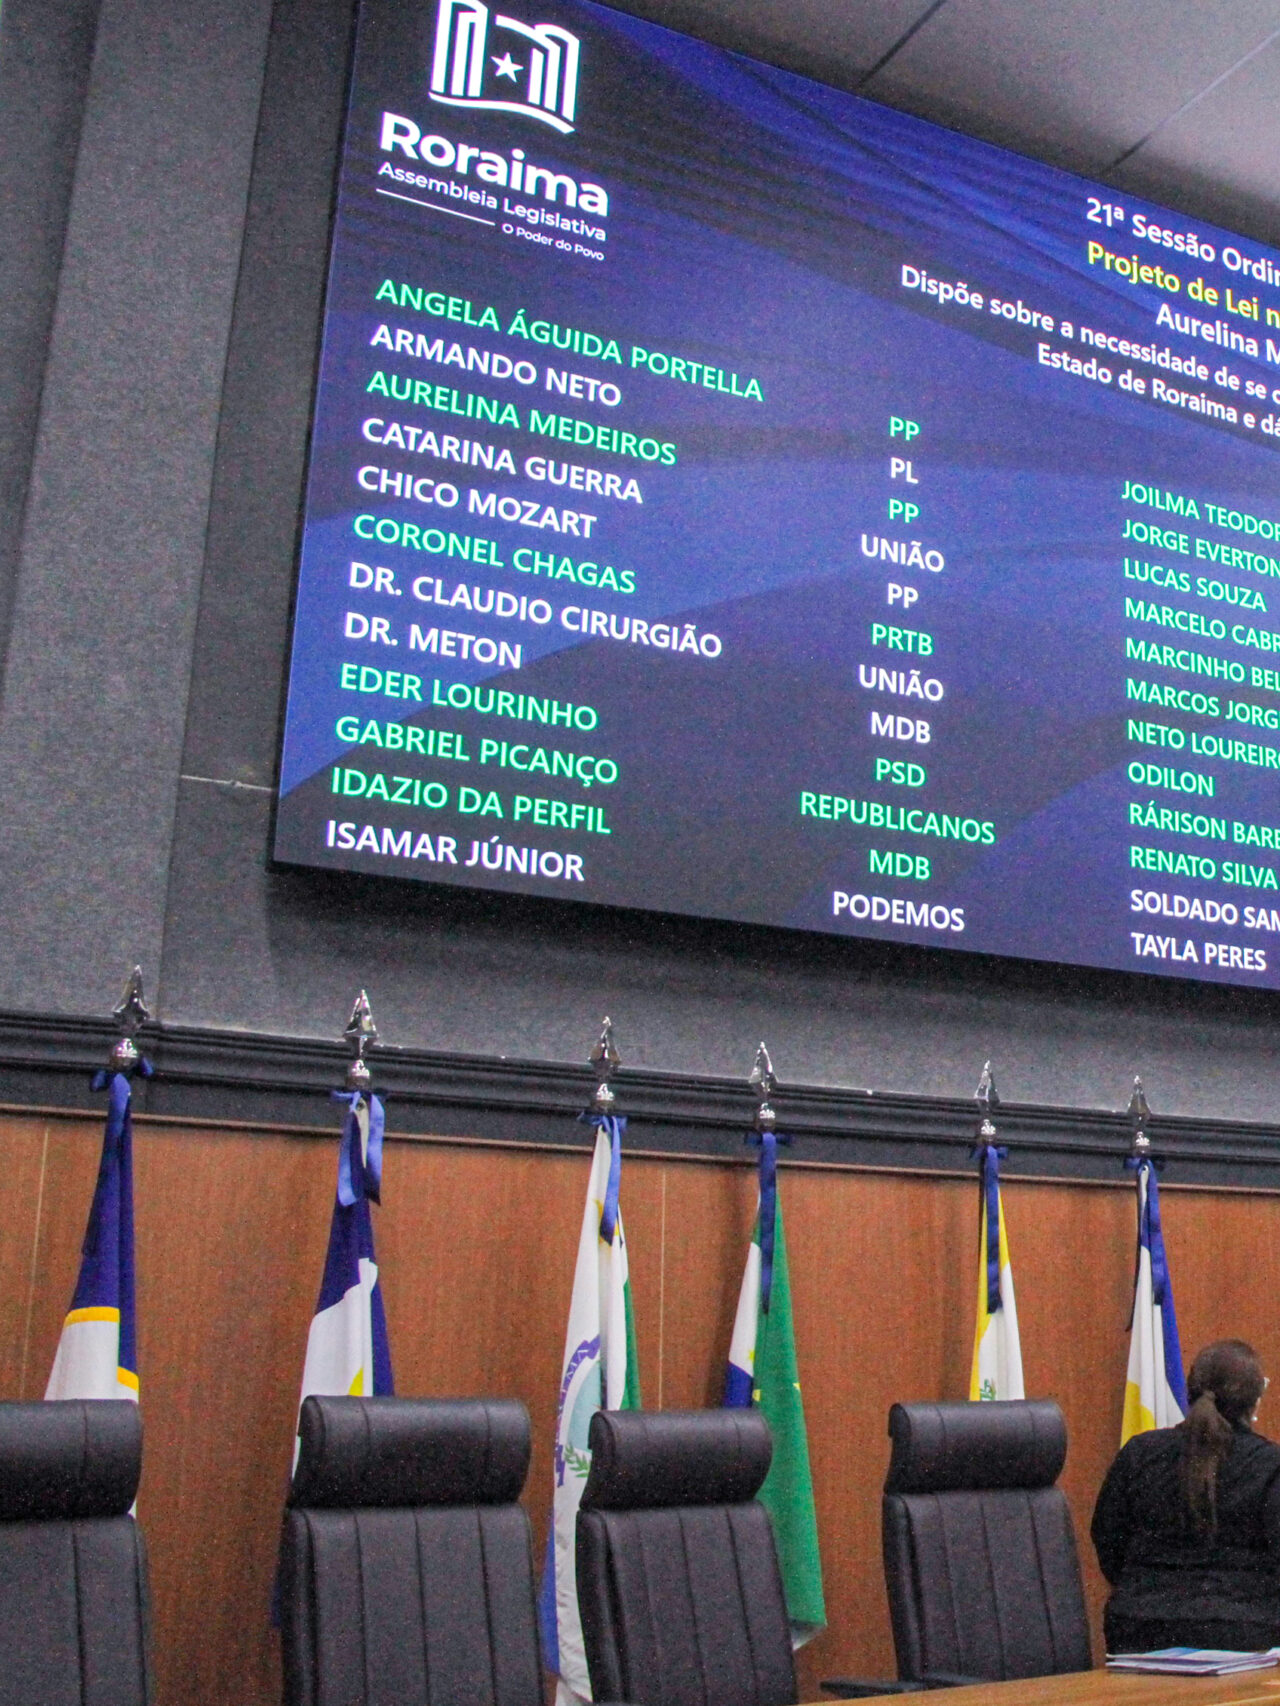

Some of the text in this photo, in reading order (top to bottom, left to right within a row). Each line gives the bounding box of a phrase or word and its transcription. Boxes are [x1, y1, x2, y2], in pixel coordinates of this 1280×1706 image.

[381, 112, 608, 216] Roraima
[378, 162, 606, 241] Assembleia Legislativa
[503, 224, 604, 261] O Poder do Povo
[1087, 198, 1124, 227] 21ª
[1132, 215, 1215, 262] Sessão
[1088, 241, 1180, 292] Projeto
[1187, 278, 1218, 306] de
[1226, 289, 1258, 321] Lei
[375, 279, 765, 402] ANGELA ÁGUIDA PORTELLA
[902, 265, 983, 309] Dispõe
[990, 299, 1054, 332] sobre
[1061, 322, 1073, 338] a
[1081, 328, 1209, 381] necessidade
[1214, 366, 1240, 390] de
[1245, 381, 1267, 399] se
[1156, 304, 1258, 357] Aurelina
[371, 325, 621, 407] ARMANDO NETO
[1039, 343, 1112, 384] Estado
[1118, 369, 1146, 394] de
[1152, 378, 1237, 423] Roraima
[1243, 413, 1255, 428] e
[366, 371, 677, 465] AURELINA MEDEIROS
[890, 416, 920, 441] PP
[363, 418, 643, 504] CATARINA GUERRA
[891, 457, 919, 484] PL
[358, 466, 597, 538] CHICO MOZART
[887, 498, 921, 524] PP
[1120, 481, 1202, 520] JOILMA
[353, 514, 637, 594] CORONEL CHAGAS
[861, 534, 944, 573] UNIÃO
[1122, 519, 1191, 555] JORGE
[888, 583, 919, 608] PP
[1123, 558, 1268, 613] LUCAS SOUZA
[350, 562, 722, 658] DR. CLAUDIO CIRURGIÃO
[1124, 597, 1230, 640] MARCELO
[345, 612, 523, 669] DR. METON
[872, 623, 934, 656] PRTB
[1125, 637, 1247, 683] MARCINHO
[340, 663, 598, 731] EDER LOURINHO
[859, 664, 944, 701] UNIÃO
[1126, 678, 1221, 717] MARCOS
[871, 712, 930, 743] MDB
[1127, 719, 1188, 750] NETO
[335, 716, 618, 787] GABRIEL PICANÇO
[876, 758, 926, 787] PSD
[332, 767, 611, 834] IDAZIO DA PERFIL
[1128, 762, 1215, 797] ODILON
[800, 791, 995, 845] REPUBLICANOS
[1128, 800, 1228, 841] RÁRISON
[328, 820, 584, 881] ISAMAR JÚNIOR
[870, 849, 931, 880] MDB
[1130, 846, 1279, 890] RENATO SILVA
[834, 891, 965, 931] PODEMOS
[1131, 890, 1238, 925] SOLDADO
[1131, 932, 1266, 971] TAYLA PERES
